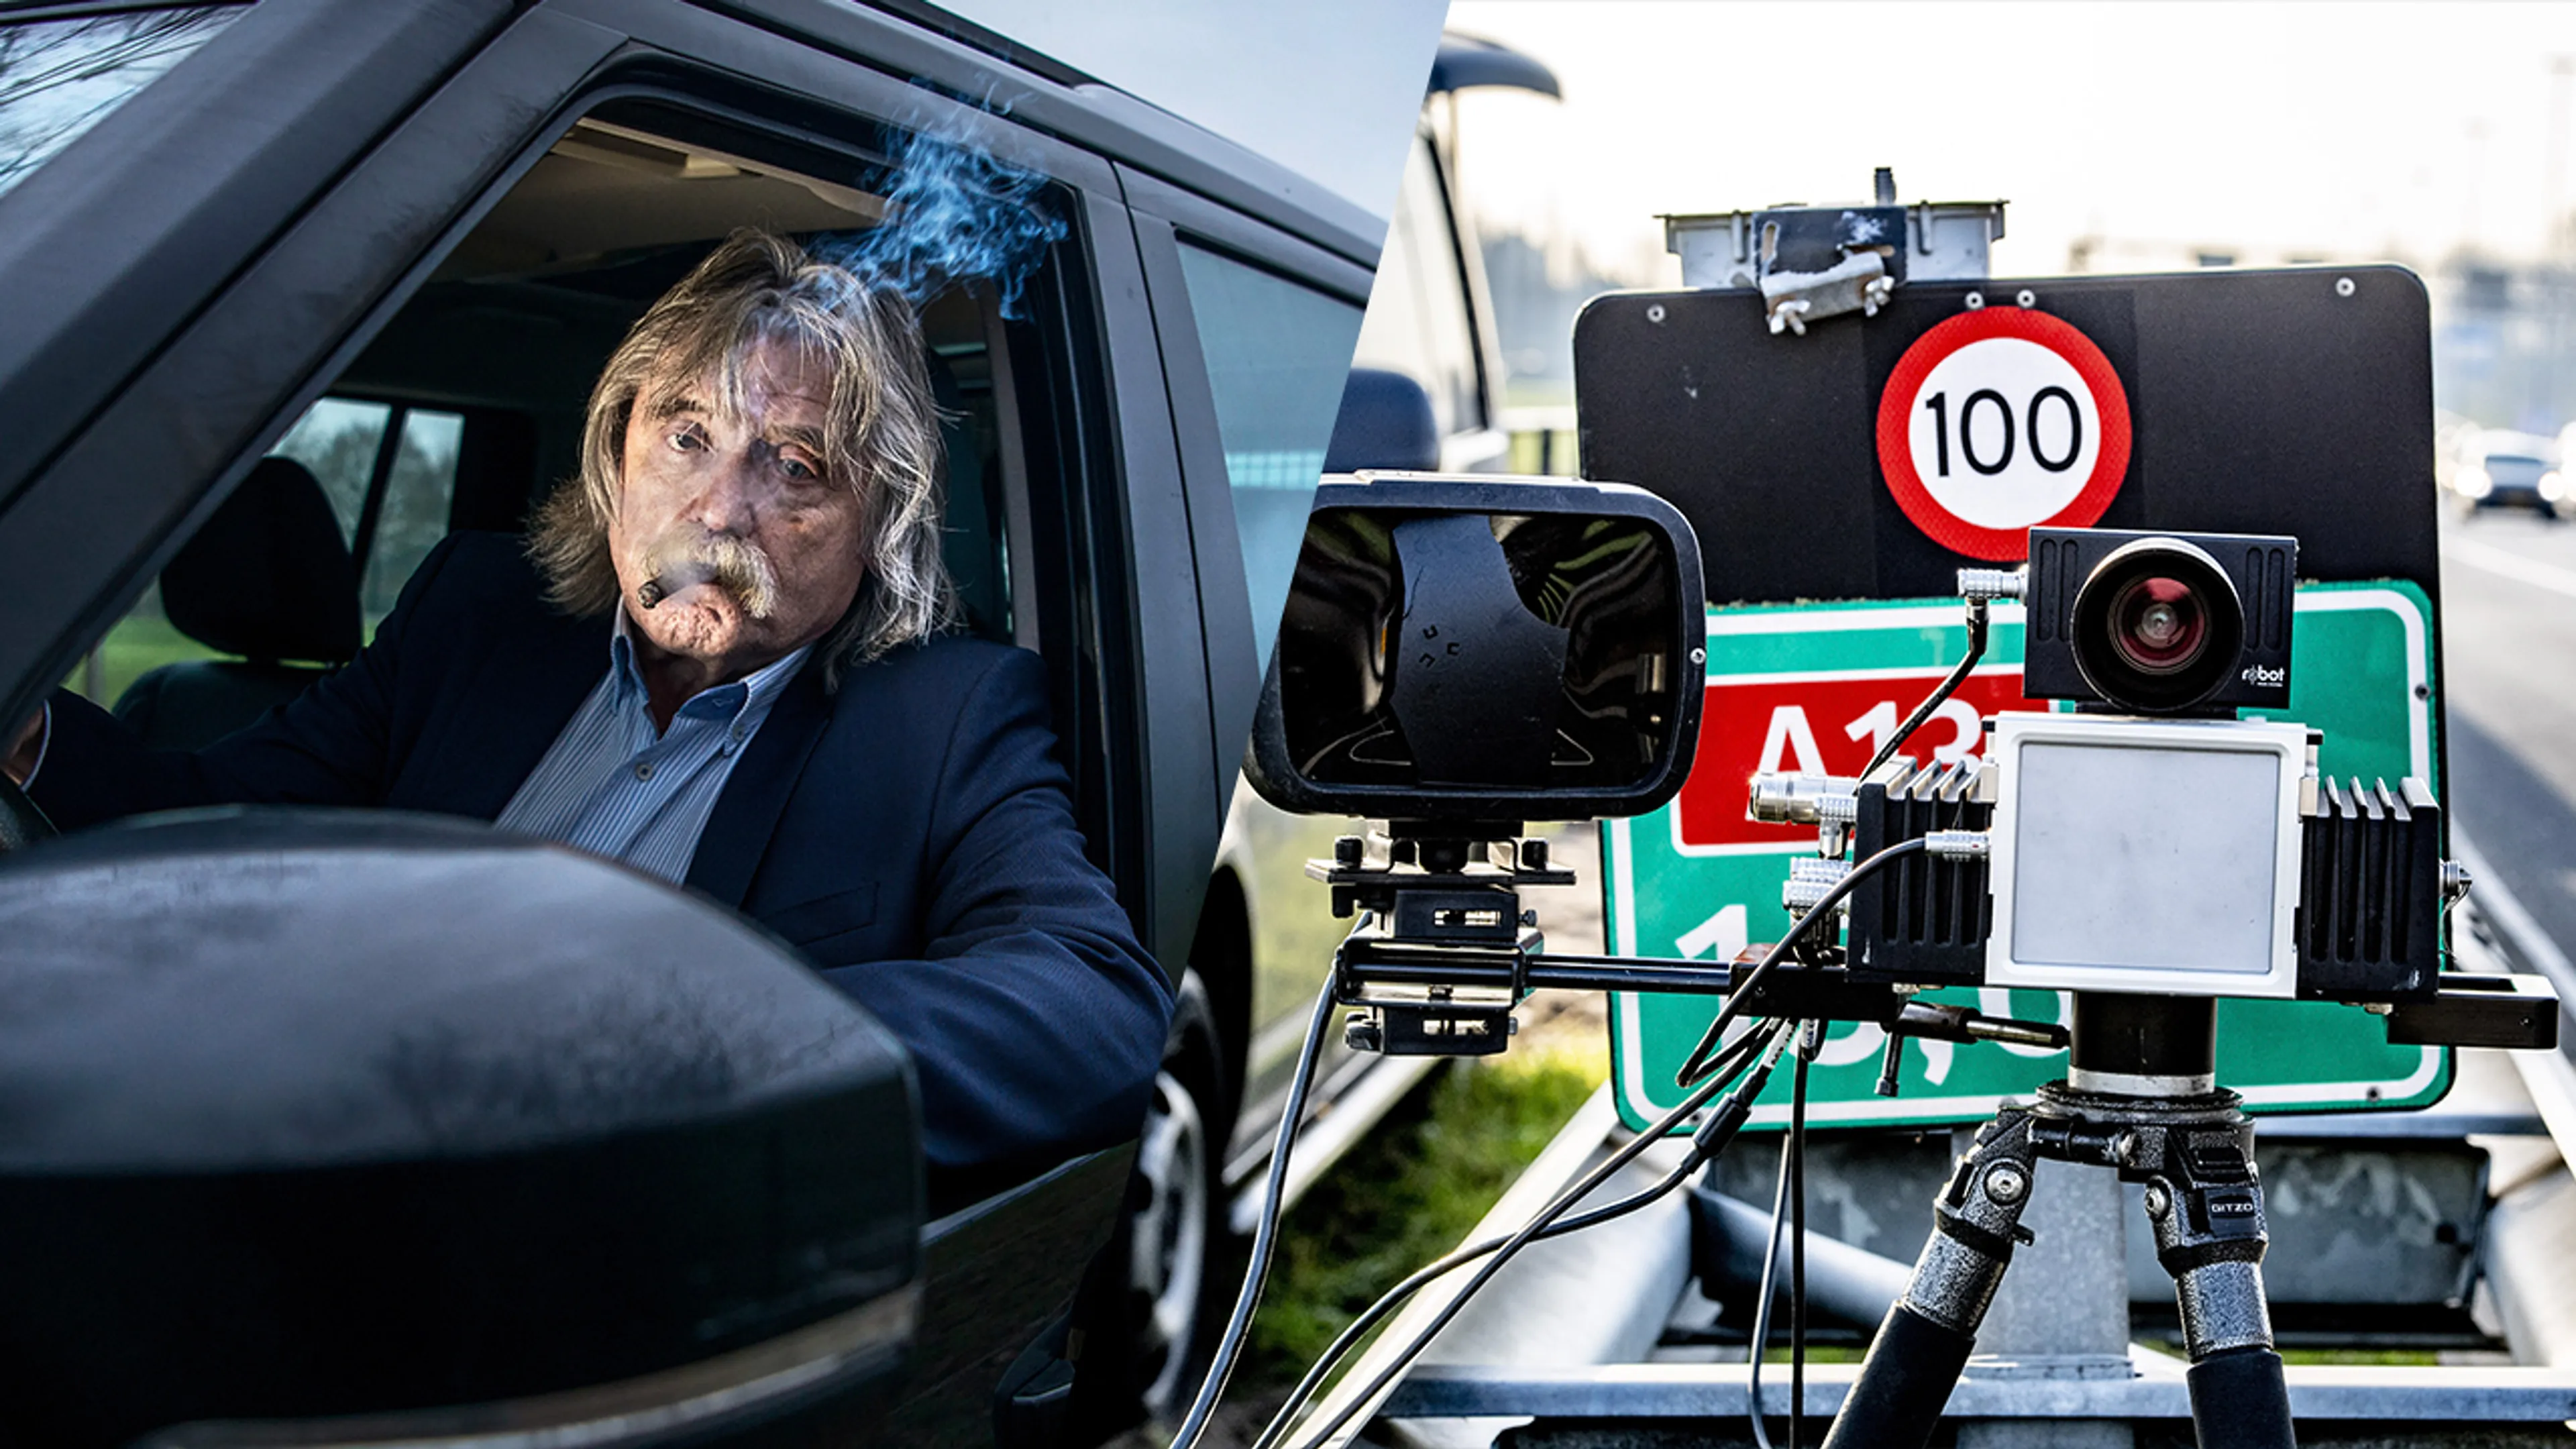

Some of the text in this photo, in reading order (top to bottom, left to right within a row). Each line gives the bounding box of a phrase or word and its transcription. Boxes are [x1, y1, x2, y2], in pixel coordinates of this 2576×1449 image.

[1925, 385, 2082, 477] 100
[2242, 664, 2285, 683] robot
[2211, 1202, 2253, 1213] GITZO
